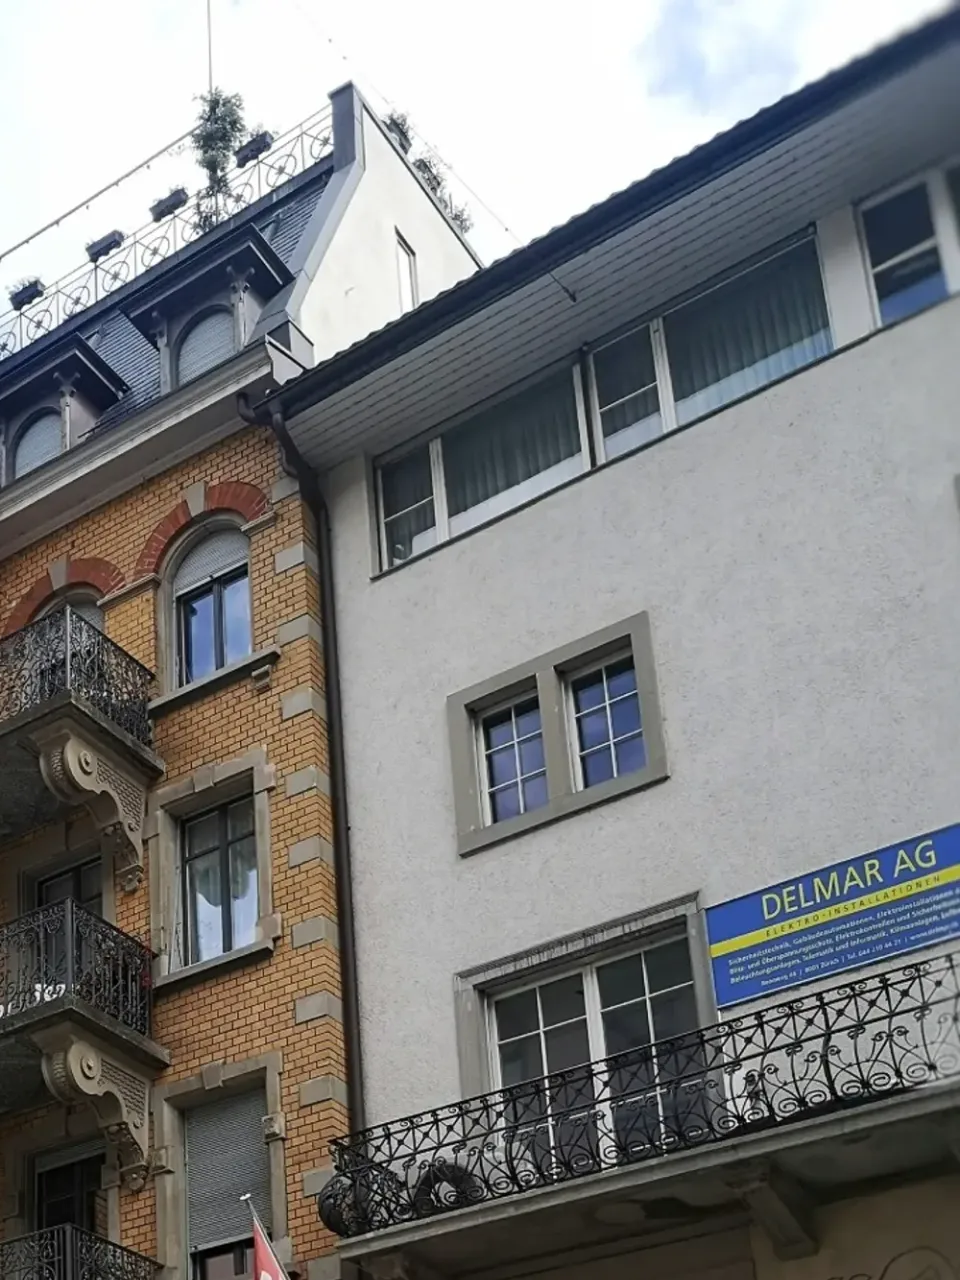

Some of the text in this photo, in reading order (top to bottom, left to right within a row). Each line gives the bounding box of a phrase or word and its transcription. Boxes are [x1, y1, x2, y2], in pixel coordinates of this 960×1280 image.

[761, 839, 937, 921] DELMAR AG
[765, 874, 941, 938] ELEKTRO-INSTALLATIONEN
